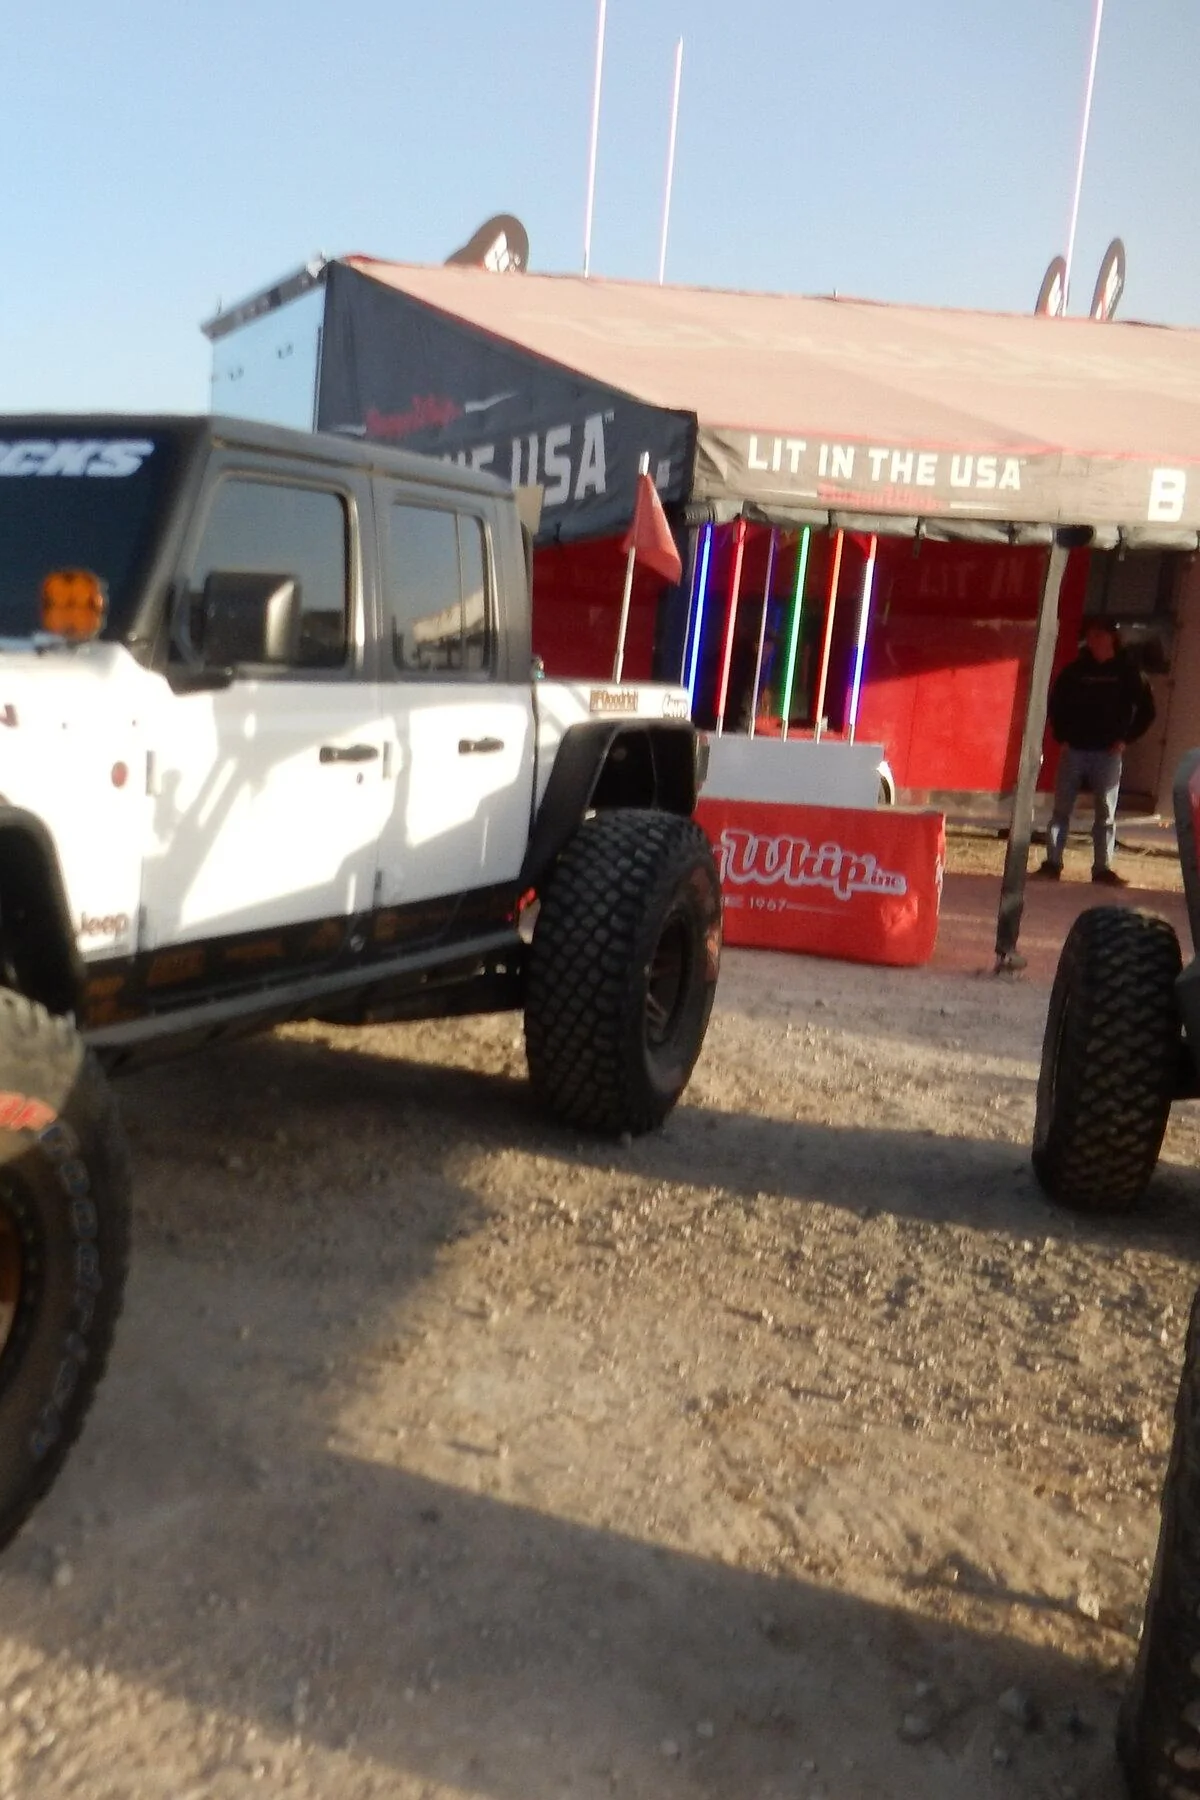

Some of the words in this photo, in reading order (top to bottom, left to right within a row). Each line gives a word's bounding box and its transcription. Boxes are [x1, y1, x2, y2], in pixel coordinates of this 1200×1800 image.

[748, 435, 807, 474] LIT
[818, 443, 855, 480] IN
[869, 447, 940, 486] THE
[950, 454, 1022, 491] USA
[1148, 468, 1186, 522] B
[720, 829, 878, 900] Whip
[750, 896, 787, 912] 1967
